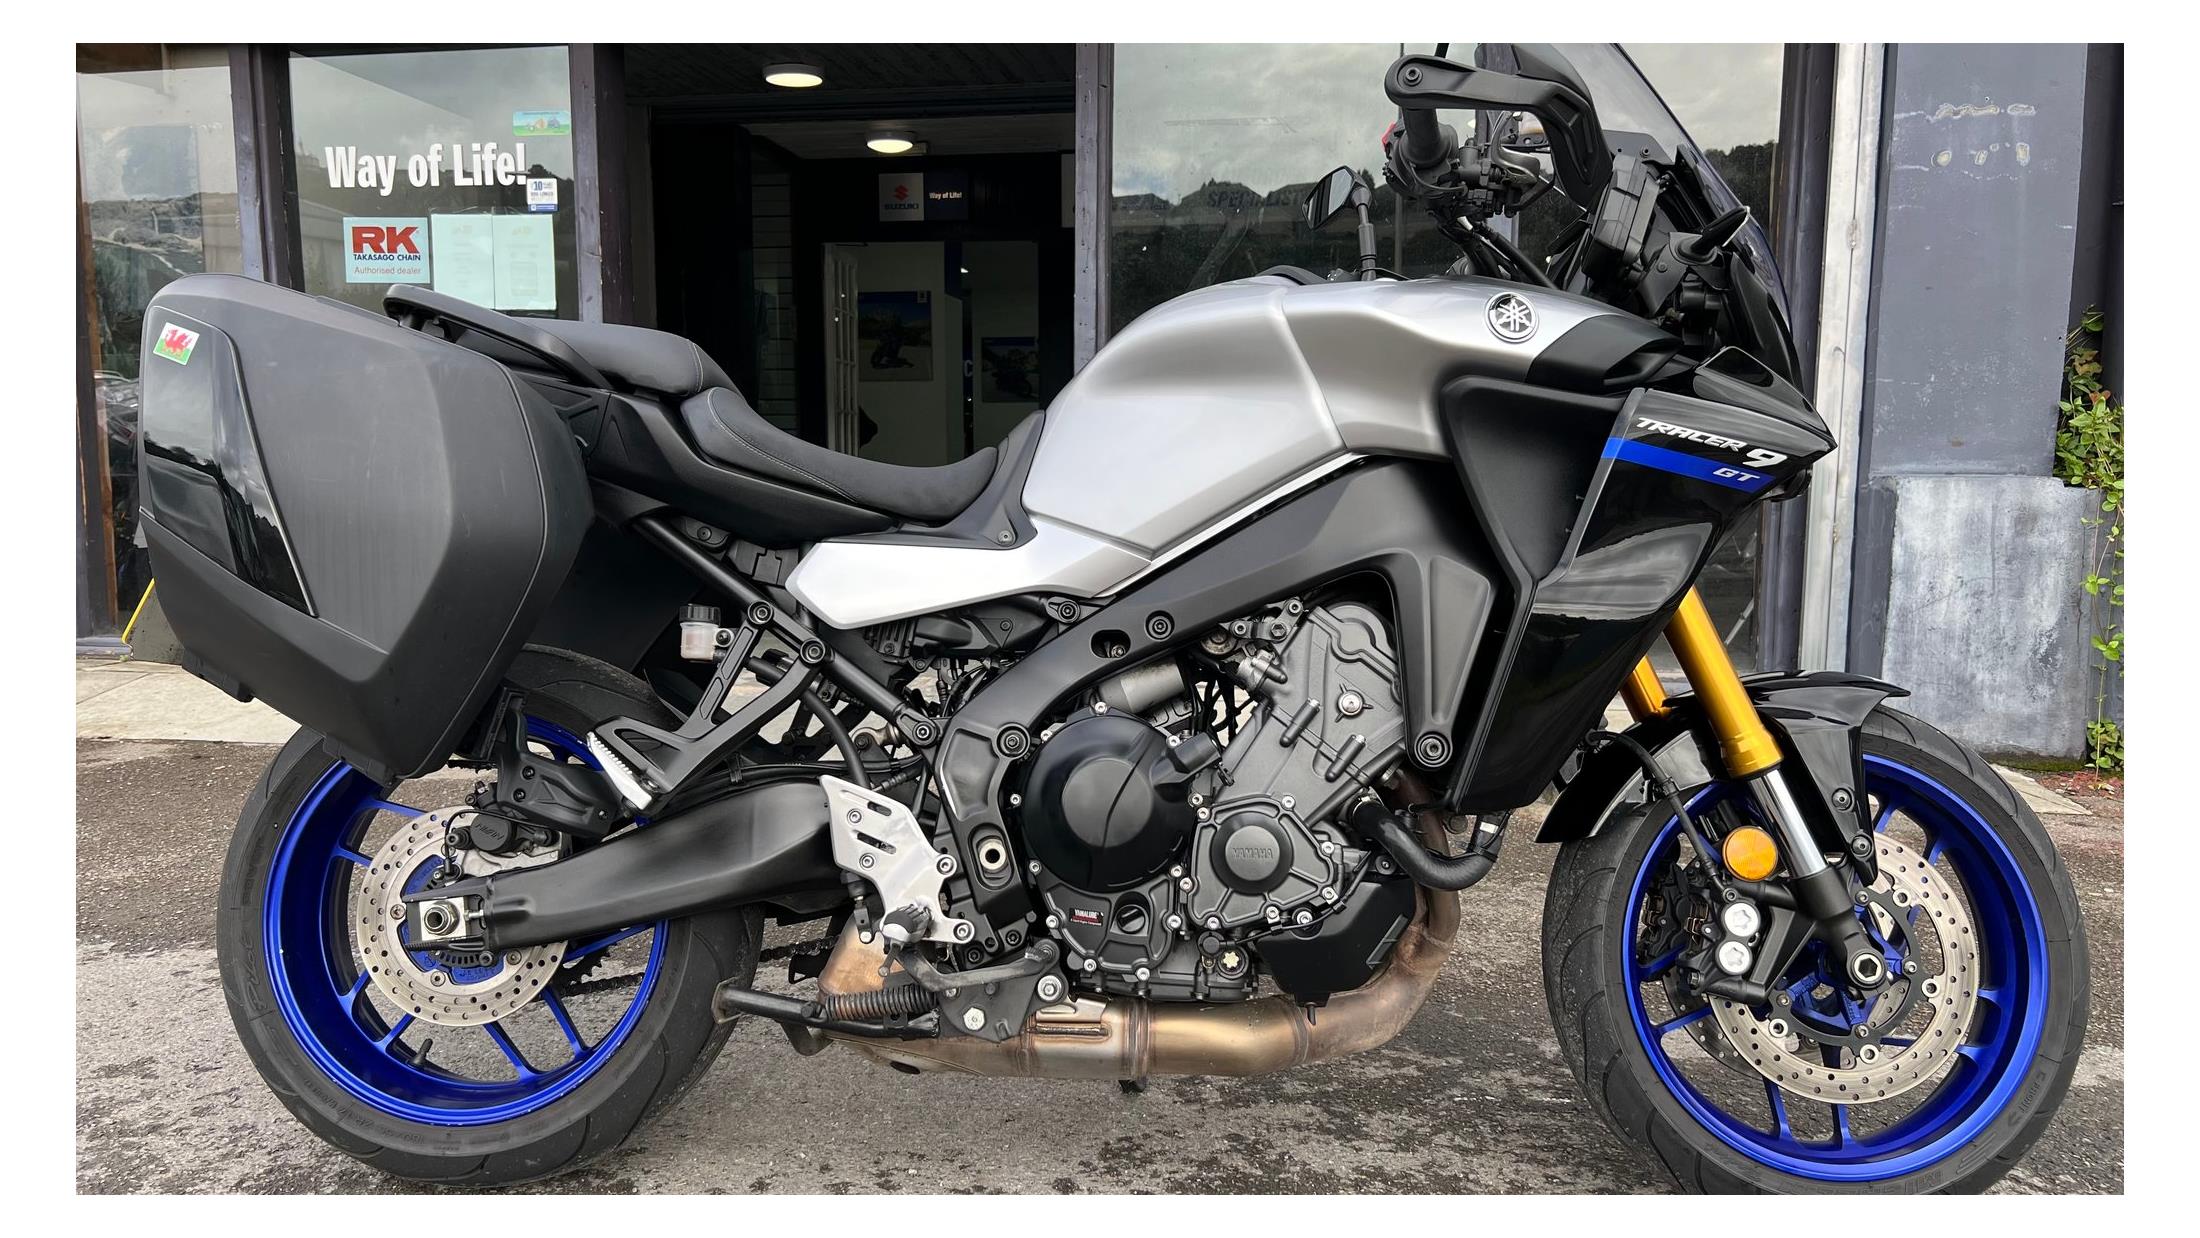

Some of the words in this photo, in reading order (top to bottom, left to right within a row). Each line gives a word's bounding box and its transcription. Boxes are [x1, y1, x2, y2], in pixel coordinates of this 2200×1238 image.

[324, 145, 397, 197] Way
[407, 143, 444, 188] of
[453, 142, 527, 187] Life!
[929, 192, 941, 200] Way
[351, 226, 420, 254] RK
[353, 253, 395, 261] TAKASAGO
[397, 253, 421, 261] CHAIN
[353, 266, 395, 275] Authorised
[396, 266, 421, 275] dealer
[1636, 417, 1748, 453] TRACER
[1742, 448, 1788, 468] 9
[1712, 466, 1761, 483] GT
[1231, 847, 1274, 860] YAMAHA
